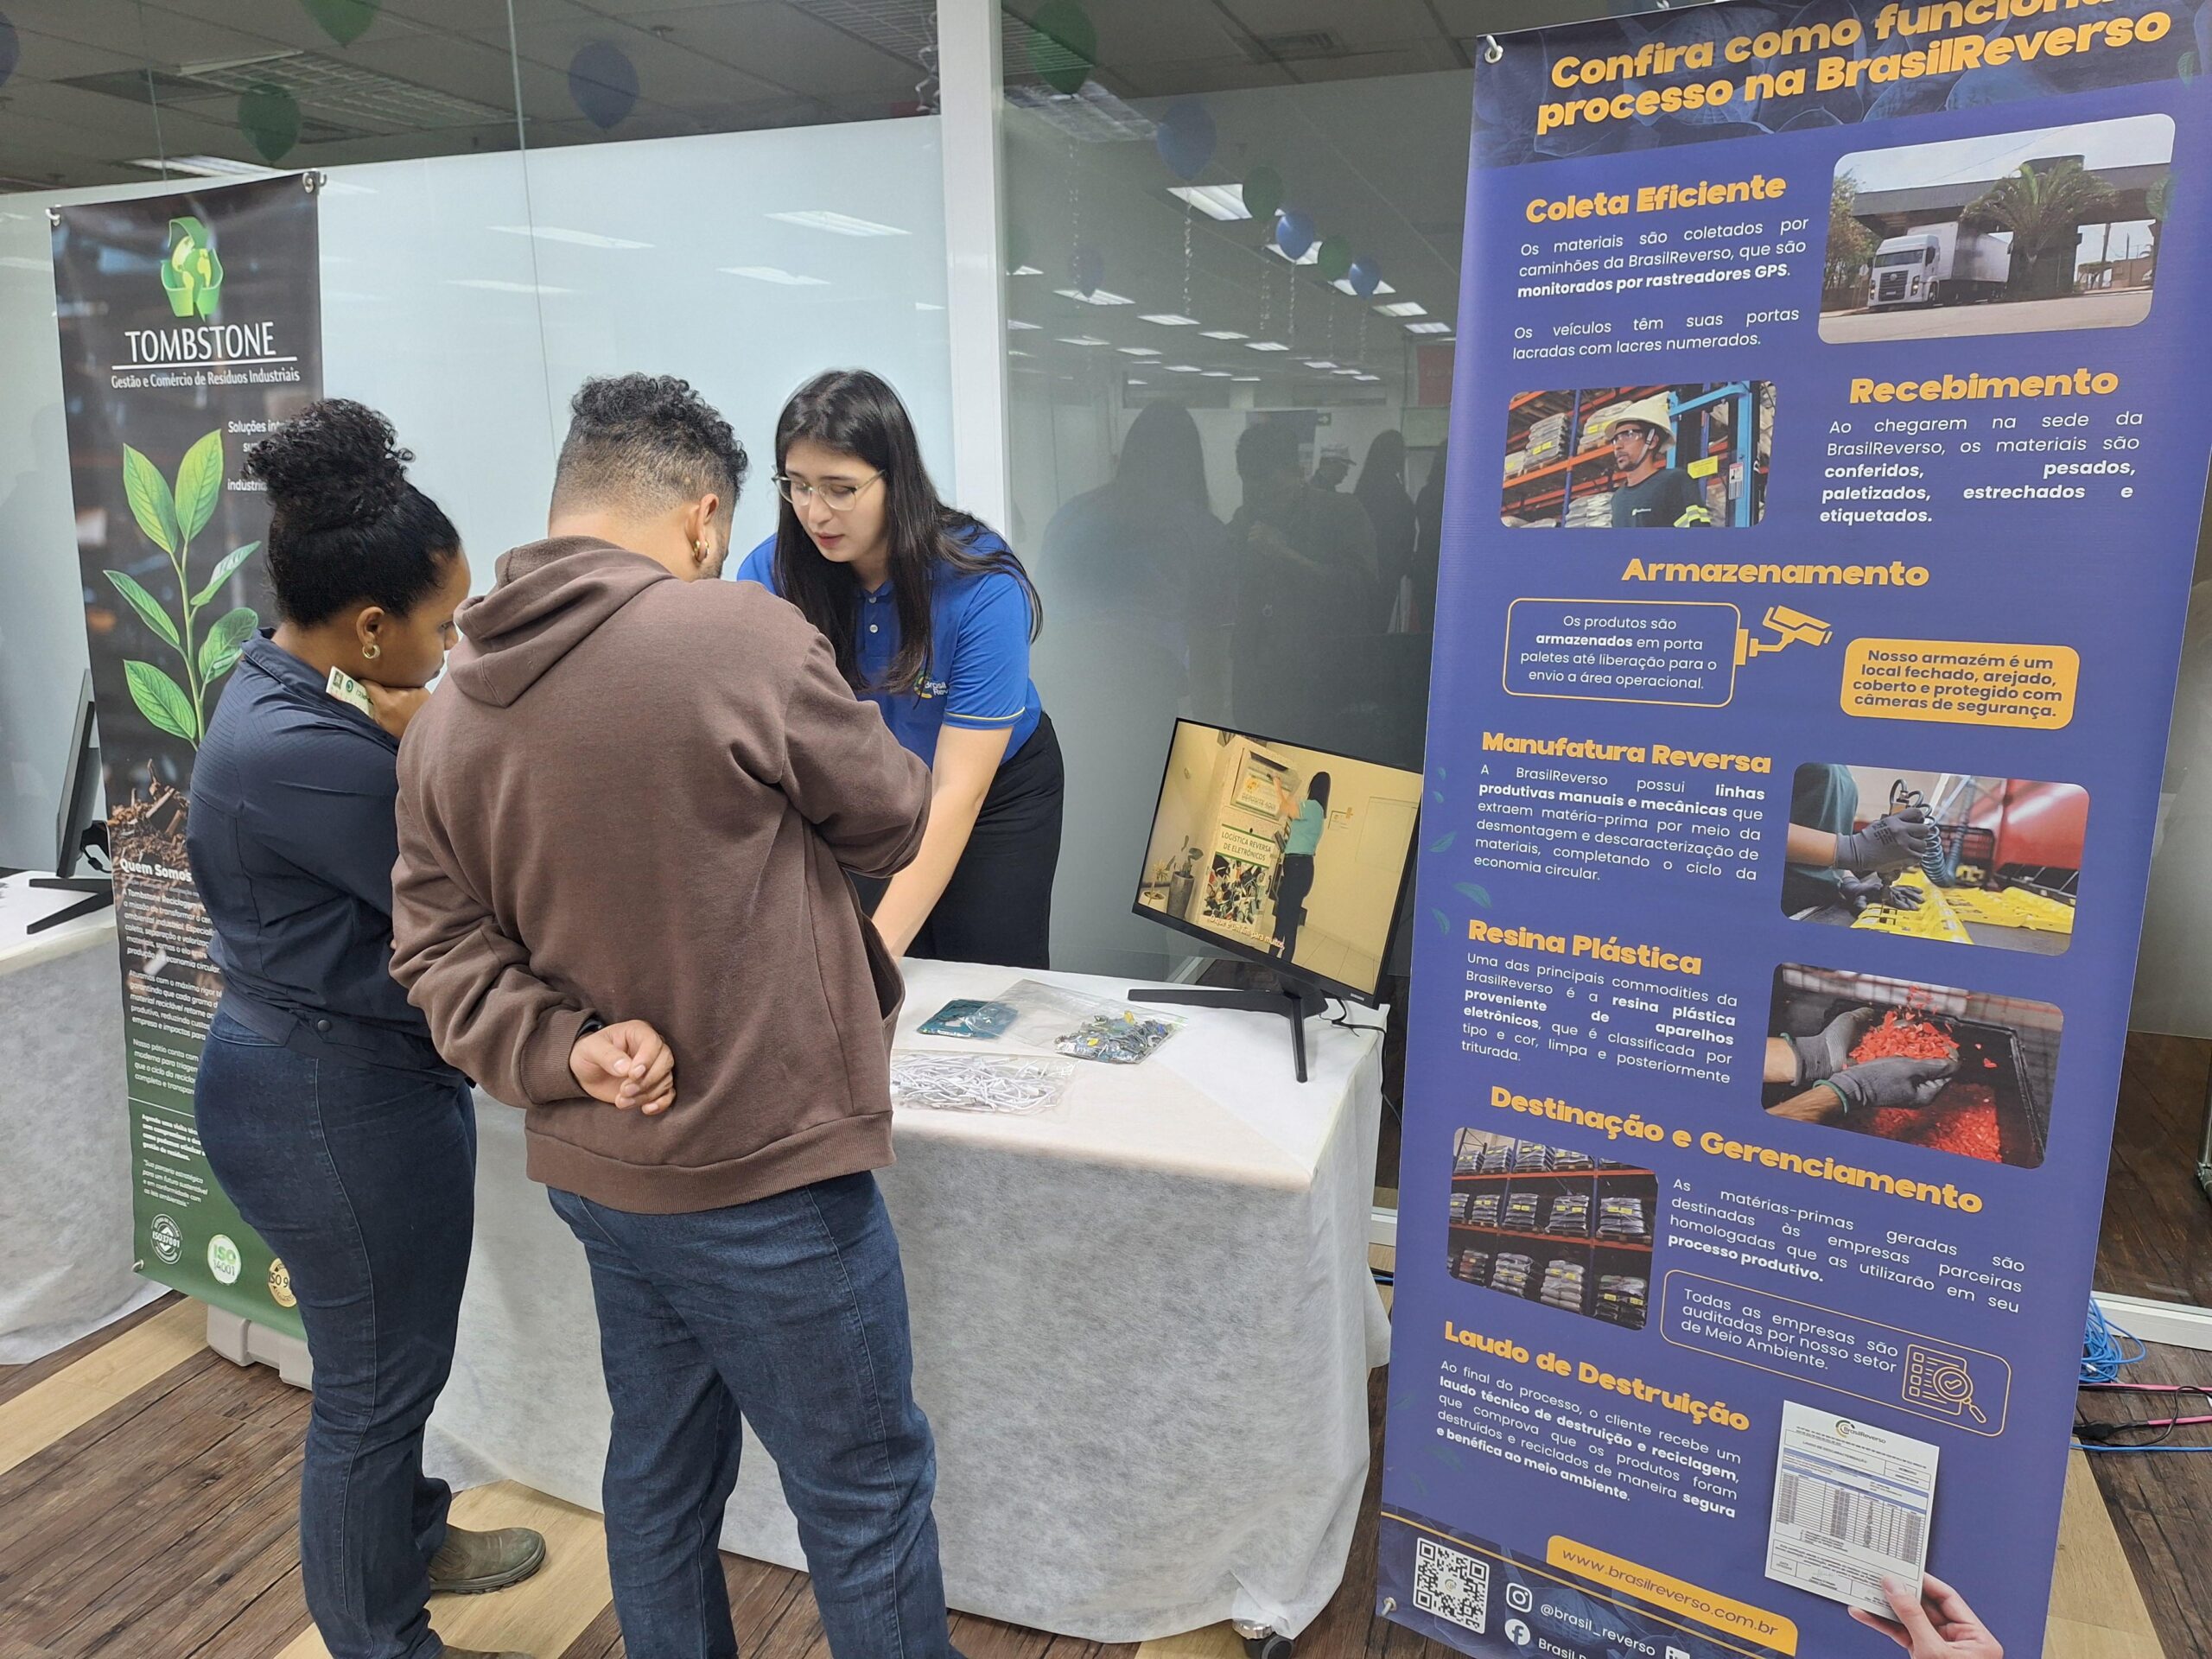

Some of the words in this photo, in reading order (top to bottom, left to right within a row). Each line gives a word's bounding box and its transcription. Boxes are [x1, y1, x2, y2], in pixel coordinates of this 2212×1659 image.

[1550, 41, 1713, 88] Confira
[1723, 17, 1862, 63] como
[1873, 0, 2115, 41] funcio
[1536, 79, 1733, 135] processo
[1743, 67, 1806, 101] na
[1815, 10, 2171, 91] BrasilReverso
[1525, 191, 1630, 223] Coleta
[1636, 174, 1786, 213] Eficiente
[1520, 243, 1539, 256] Os
[1553, 233, 1624, 253] materiais
[1638, 231, 1668, 245] são
[1683, 221, 1763, 240] coletados
[1779, 218, 1808, 236] por
[1517, 277, 1613, 298] monitorados
[1615, 276, 1643, 294] por
[1645, 268, 1751, 287] rastreadores
[1754, 263, 1790, 278] GPS.
[124, 321, 276, 363] TOMBSTONE
[1512, 344, 1575, 359] lacradas
[1579, 343, 1611, 355] com
[1616, 340, 1662, 353] lacres
[1665, 332, 1761, 350] numerados.
[111, 375, 141, 388] Gestão
[143, 378, 149, 386] e
[149, 372, 192, 386] Comércio
[194, 371, 206, 385] de
[207, 370, 247, 384] Resíduos
[249, 368, 299, 382] Industriais
[1849, 367, 2119, 404] Recebimento
[228, 420, 266, 435] Soluções
[1827, 441, 1945, 455] BrasilReverso,
[1960, 442, 1980, 453] os
[1995, 435, 2087, 452] materiais
[2102, 435, 2139, 450] são
[1824, 462, 1923, 479] conferidos,
[2042, 459, 2135, 480] pesados,
[1821, 485, 1930, 504] paletizados,
[1962, 484, 2085, 499] estrechados
[2120, 486, 2133, 498] e
[1819, 507, 1932, 526] etiquetados.
[1620, 557, 1929, 586] Armazenamento
[1535, 634, 1633, 647] armazenados
[1636, 638, 1659, 648] em
[1662, 639, 1702, 652] porta
[1867, 649, 1918, 663] Nosso
[1921, 652, 2005, 667] armazém
[2008, 654, 2019, 667] é
[2023, 658, 2053, 669] um
[1528, 669, 1564, 681] envio
[1567, 672, 1576, 682] a
[1580, 671, 1611, 683] área
[1615, 675, 1703, 689] operacional.
[1861, 663, 1901, 677] local
[1904, 664, 1979, 683] fechado,
[1982, 670, 2056, 687] arejado,
[1853, 695, 1928, 709] câmeras
[1931, 697, 1953, 710] de
[1956, 701, 2056, 720] segurança.
[1481, 731, 1645, 763] Manufatura
[1650, 743, 1771, 773] Reversa
[1221, 831, 1249, 845] LOGÍSTICA
[1249, 840, 1271, 852] REVERSA
[1223, 842, 1230, 850] DE
[1231, 845, 1266, 861] ELETRÔNICOS
[1476, 818, 1577, 841] desmontagem
[1581, 831, 1590, 841] e
[1593, 830, 1733, 859] descaracterização
[1738, 847, 1758, 861] de
[119, 857, 154, 876] Quem
[154, 864, 193, 882] Somos
[1473, 855, 1541, 873] economia
[1544, 863, 1600, 880] circular.
[1468, 918, 1566, 954] Resina
[1572, 934, 1701, 975] Plástica
[1467, 951, 1497, 967] Uma
[1504, 958, 1529, 972] das
[1536, 964, 1605, 984] principais
[1611, 977, 1708, 1001] commodities
[1716, 993, 1737, 1007] da
[1464, 988, 1547, 1011] proveniente
[1590, 1009, 1610, 1022] de
[1655, 1022, 1733, 1046] aparelhos
[1460, 1039, 1521, 1061] triturada.
[1490, 1085, 1664, 1141] Destinação
[1671, 1129, 1692, 1147] e
[1699, 1131, 1982, 1213] Gerenciamento
[152, 1230, 181, 1249] ISO37001
[1672, 1178, 1690, 1192] As
[1719, 1190, 1853, 1230] matérias-primas
[1885, 1230, 1957, 1255] geradas
[1991, 1255, 2024, 1272] são
[213, 1244, 237, 1265] ISO
[213, 1259, 235, 1276] 14001
[1668, 1234, 1738, 1259] processo
[1740, 1252, 1823, 1281] produtivo.
[1444, 1320, 1529, 1363] Laudo
[1535, 1351, 1572, 1376] de
[1578, 1361, 1749, 1430] Destruição
[1440, 1375, 1476, 1396] laudo
[1480, 1389, 1529, 1414] técnico
[1534, 1408, 1552, 1421] de
[1555, 1414, 1632, 1447] destruição
[1637, 1442, 1646, 1452] e
[1651, 1446, 1738, 1484] reciclagem,
[1436, 1427, 1445, 1436] e
[1446, 1427, 1502, 1457] benéfica
[1503, 1450, 1522, 1463] ao
[1523, 1457, 1558, 1476] meio
[1559, 1470, 1630, 1501] ambiente.
[1562, 1549, 1778, 1635] www.brasilreverso.com.br
[1540, 1603, 1656, 1656] @brasil_reverso
